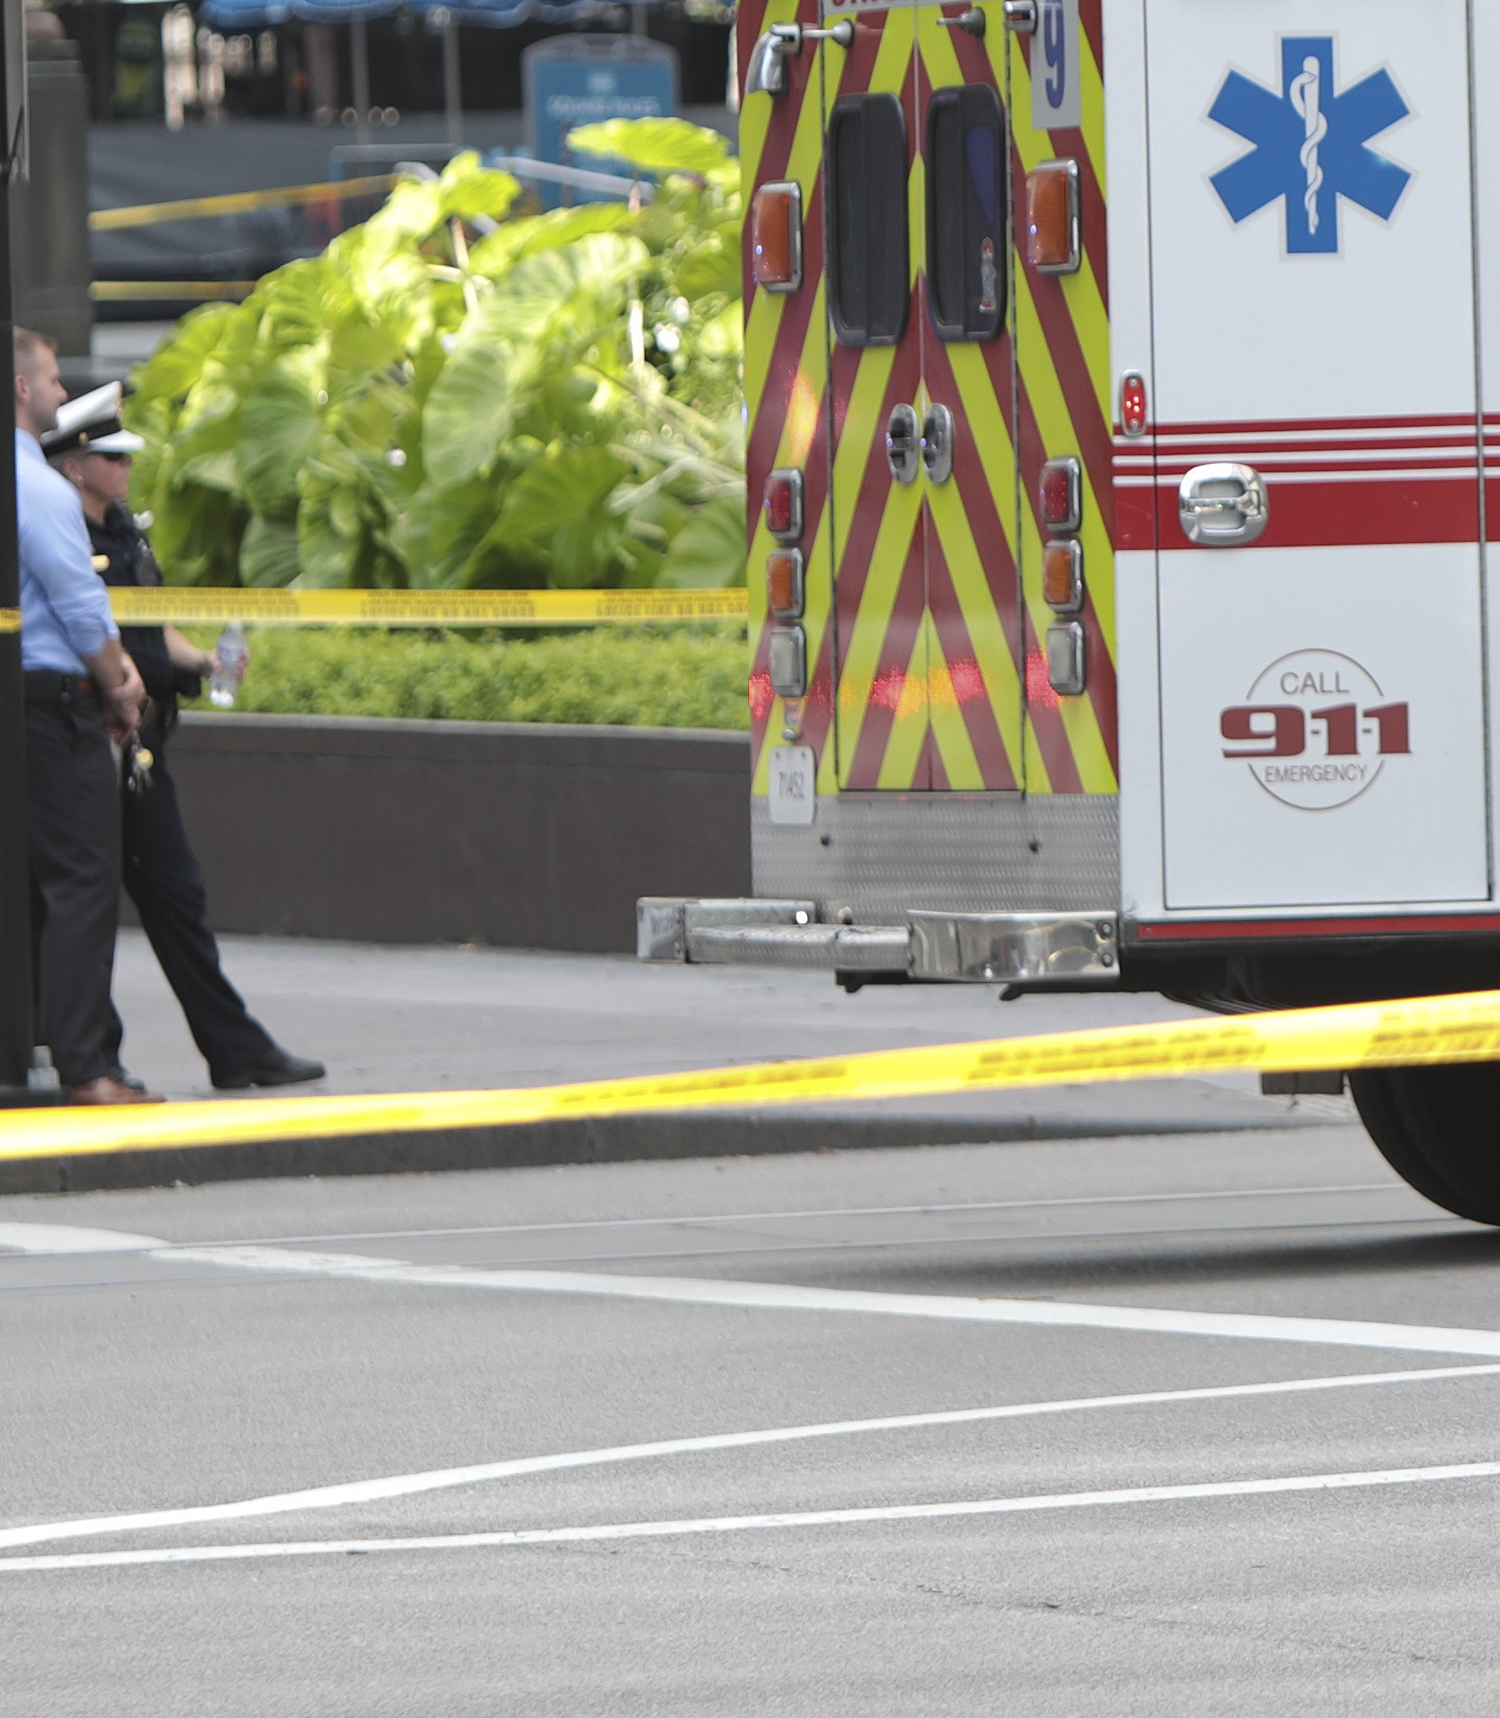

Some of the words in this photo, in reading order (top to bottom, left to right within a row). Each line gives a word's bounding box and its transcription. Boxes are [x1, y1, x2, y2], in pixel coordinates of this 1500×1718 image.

[1280, 670, 1350, 695] CALL
[1219, 701, 1413, 759] 9-1-1
[1264, 763, 1368, 783] EMERGENCY
